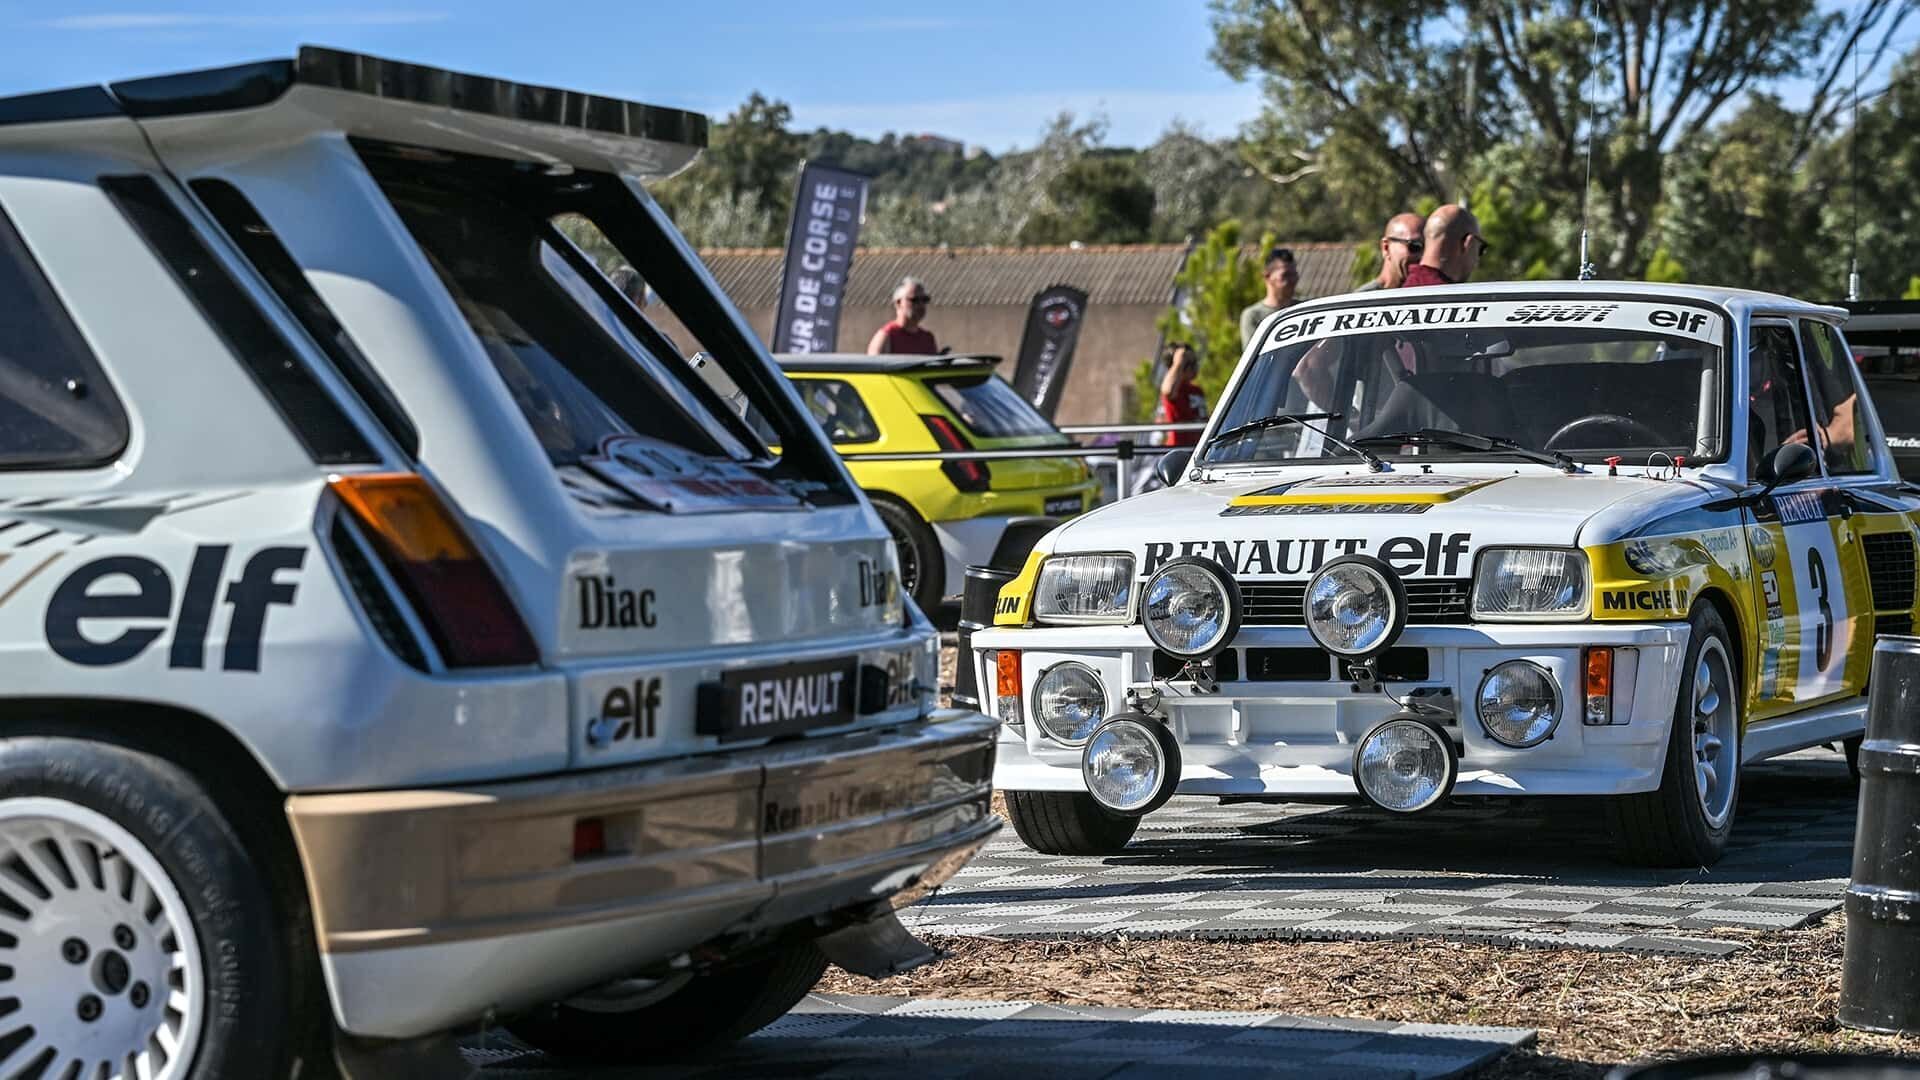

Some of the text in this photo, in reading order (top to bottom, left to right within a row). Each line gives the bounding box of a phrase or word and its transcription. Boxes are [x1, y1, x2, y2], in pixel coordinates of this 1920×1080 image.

[802, 183, 838, 272] CORSE
[794, 276, 821, 314] DE
[1274, 316, 1325, 342] elf
[1330, 306, 1489, 331] RENAULT
[1647, 309, 1708, 333] elf
[1776, 493, 1824, 522] RENAULT
[1377, 533, 1471, 576] elf
[45, 544, 310, 672] elf
[576, 573, 658, 630] Diac
[1602, 590, 1689, 610] MICHEIN
[1808, 547, 1834, 673] 3
[586, 676, 663, 747] elf
[740, 671, 844, 727] RENAULT
